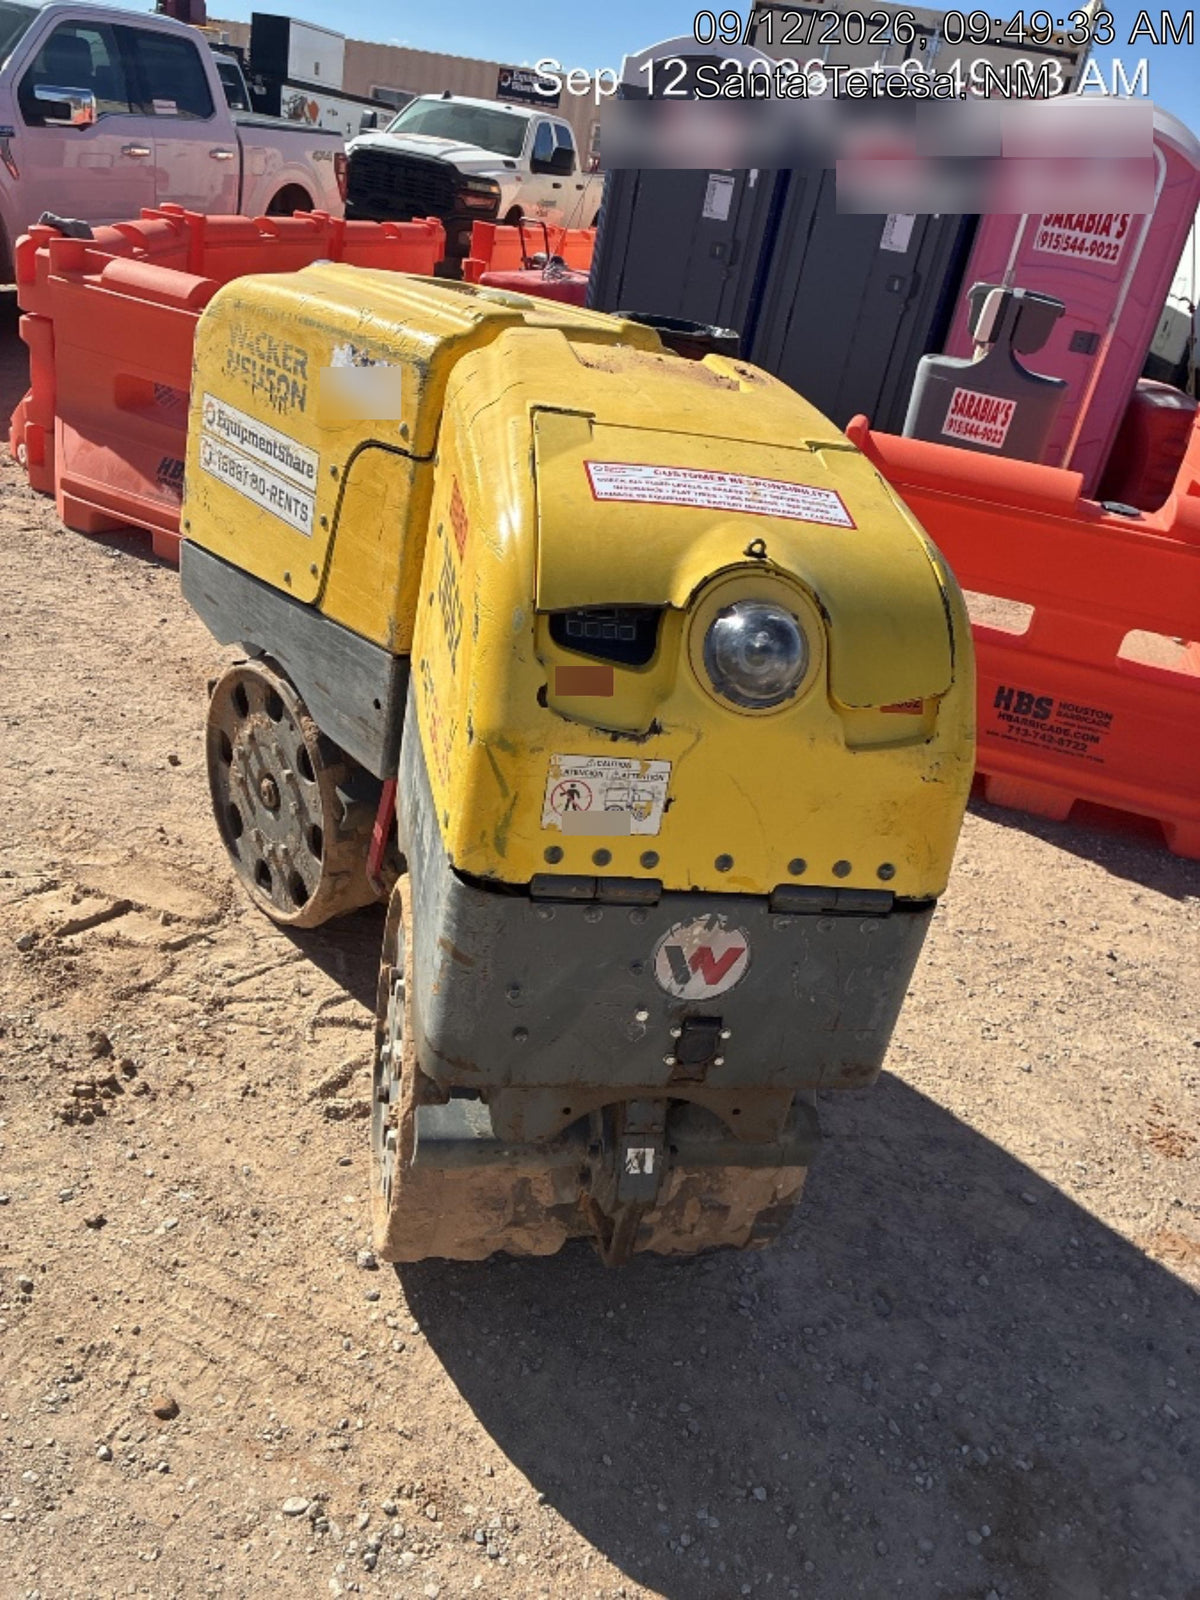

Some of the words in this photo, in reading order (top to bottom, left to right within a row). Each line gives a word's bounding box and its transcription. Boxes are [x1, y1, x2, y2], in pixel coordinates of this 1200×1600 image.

[951, 390, 1012, 427] SARABIA'S
[218, 408, 314, 479] EquipmentShare
[994, 685, 1054, 721] HBS
[1059, 702, 1114, 721] HOUSTON
[622, 772, 665, 781] ATTETION
